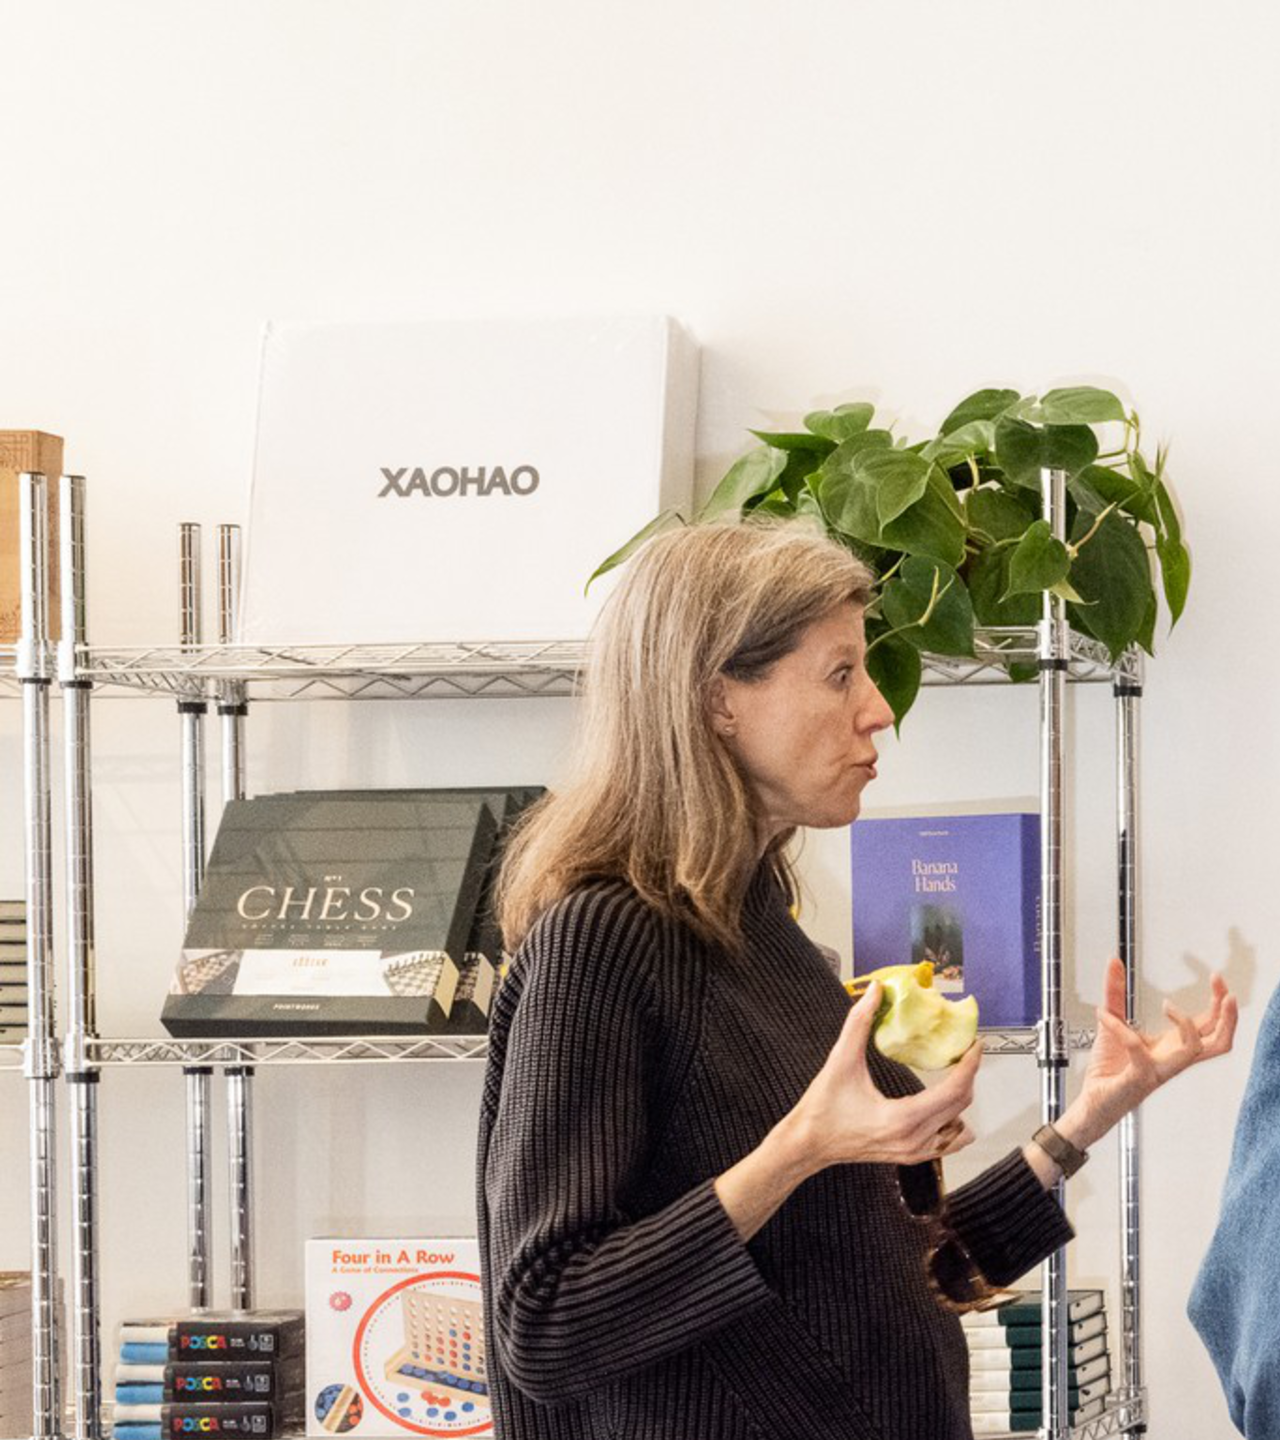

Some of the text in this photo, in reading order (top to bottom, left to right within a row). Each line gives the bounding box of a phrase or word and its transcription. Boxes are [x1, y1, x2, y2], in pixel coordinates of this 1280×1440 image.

[377, 464, 540, 497] XAOHAO
[911, 859, 958, 875] Banana
[914, 876, 956, 892] Hands
[237, 885, 415, 922] CHESS
[331, 1249, 455, 1264] Four in A Row
[180, 1335, 227, 1349] POSCA
[175, 1377, 222, 1391] POSCA
[173, 1417, 219, 1432] POSCA
